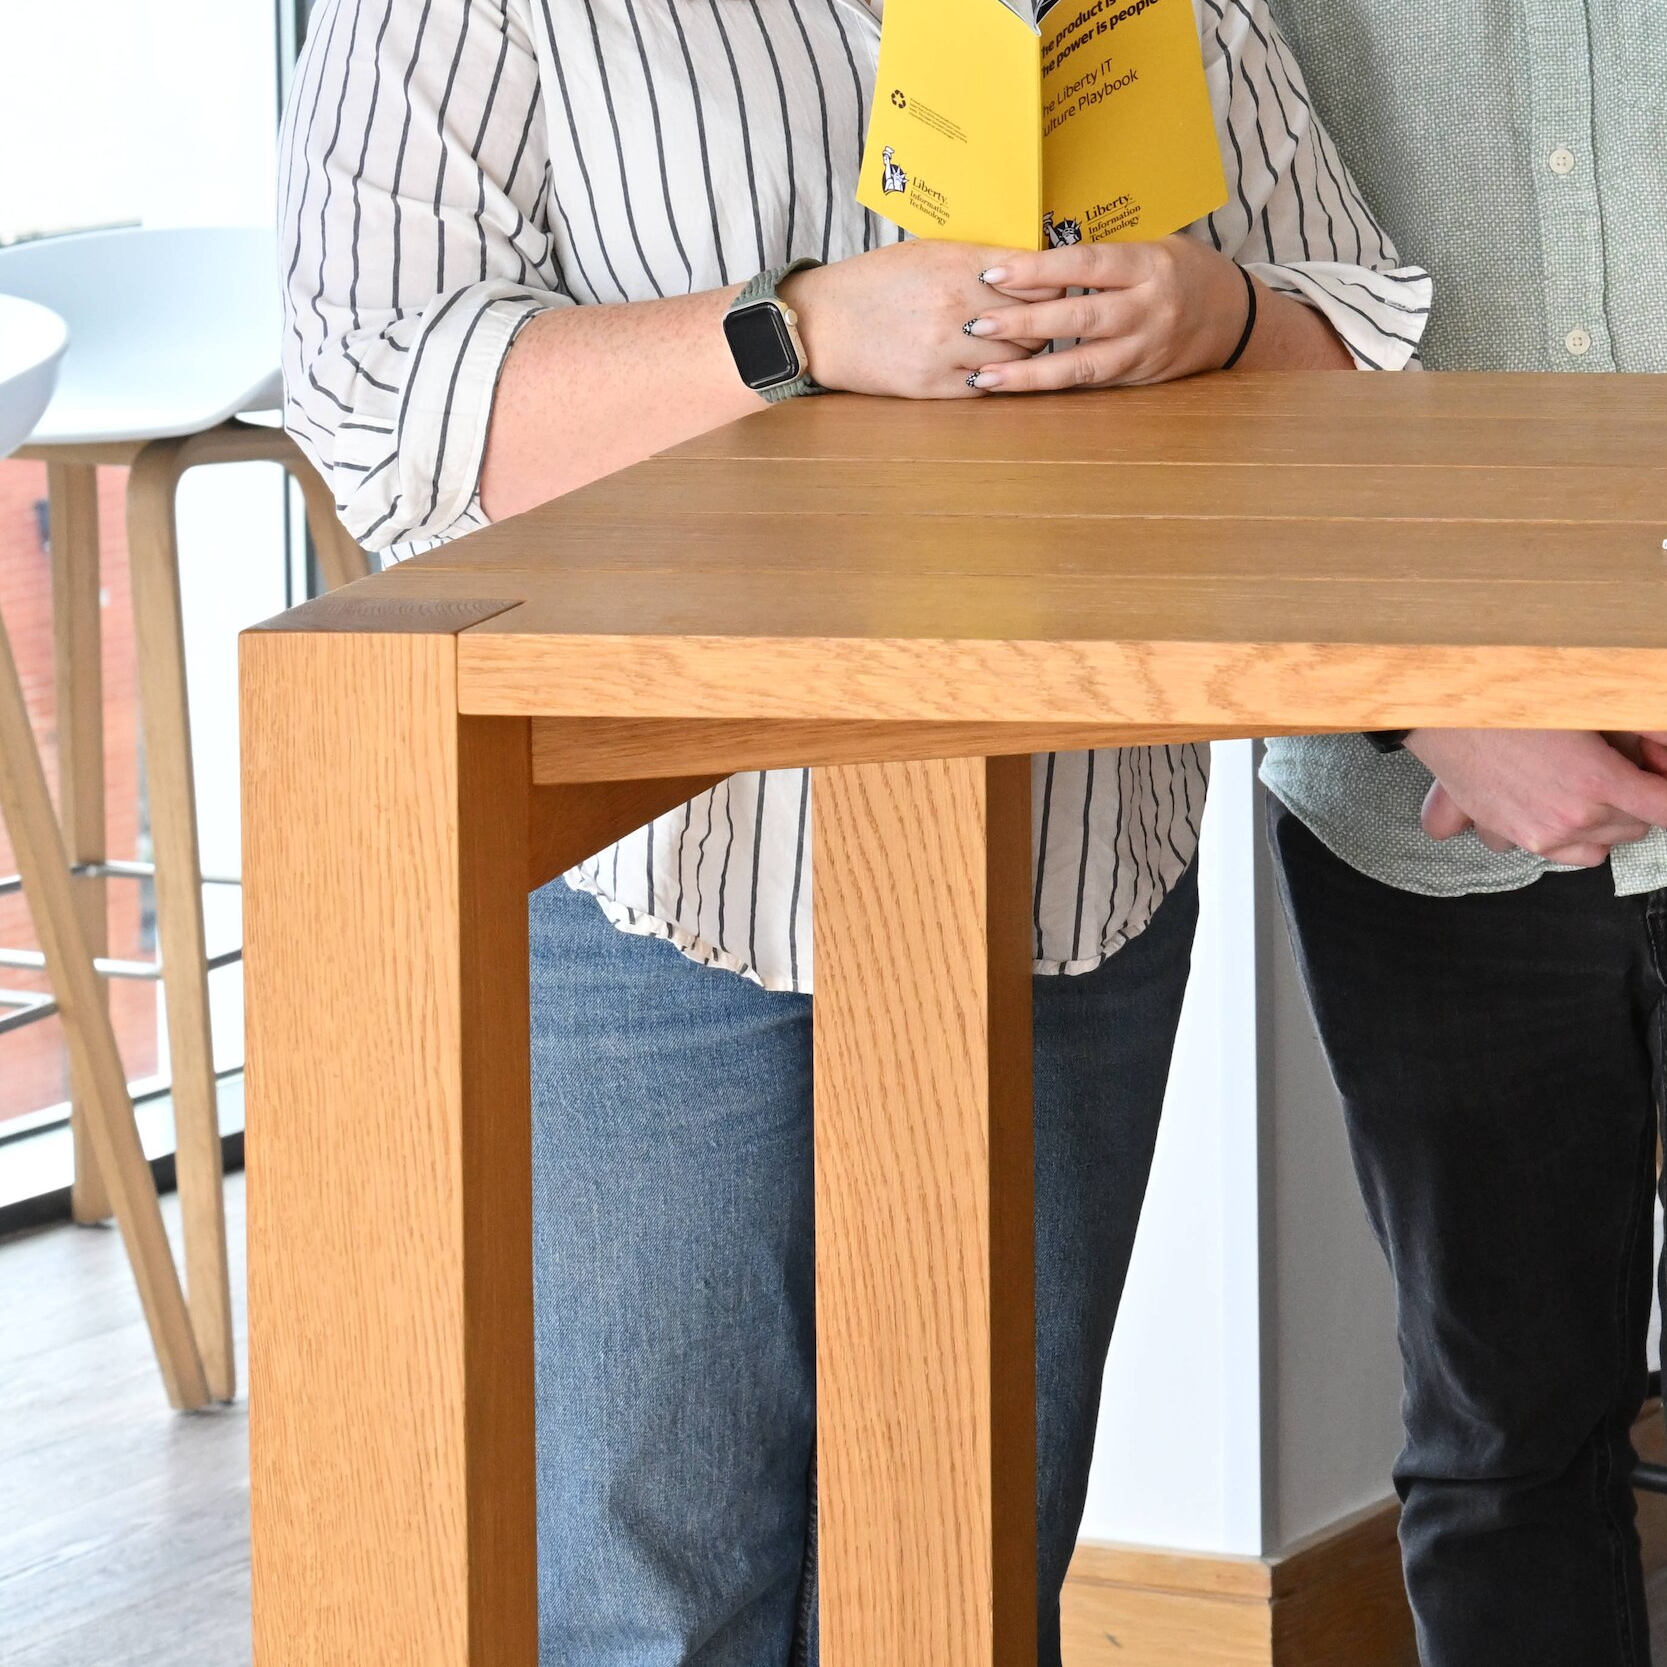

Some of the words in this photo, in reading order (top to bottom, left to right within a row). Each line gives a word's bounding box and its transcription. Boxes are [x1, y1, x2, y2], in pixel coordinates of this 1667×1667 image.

[1041, 41, 1055, 59] he
[1055, 0, 1104, 47] product
[1042, 60, 1055, 79] he
[1056, 29, 1095, 69] power
[1096, 22, 1108, 36] is
[1043, 99, 1055, 118] he
[1057, 69, 1099, 104] Liberty
[1101, 58, 1114, 77] IT
[1043, 105, 1076, 138] ulture
[1078, 69, 1139, 111] Playbook
[910, 190, 950, 219] Information
[912, 177, 947, 206] Liberty
[909, 198, 946, 226] Technology
[1085, 194, 1131, 222] Liberty
[1088, 205, 1141, 234] Information
[1090, 215, 1140, 243] Technology
